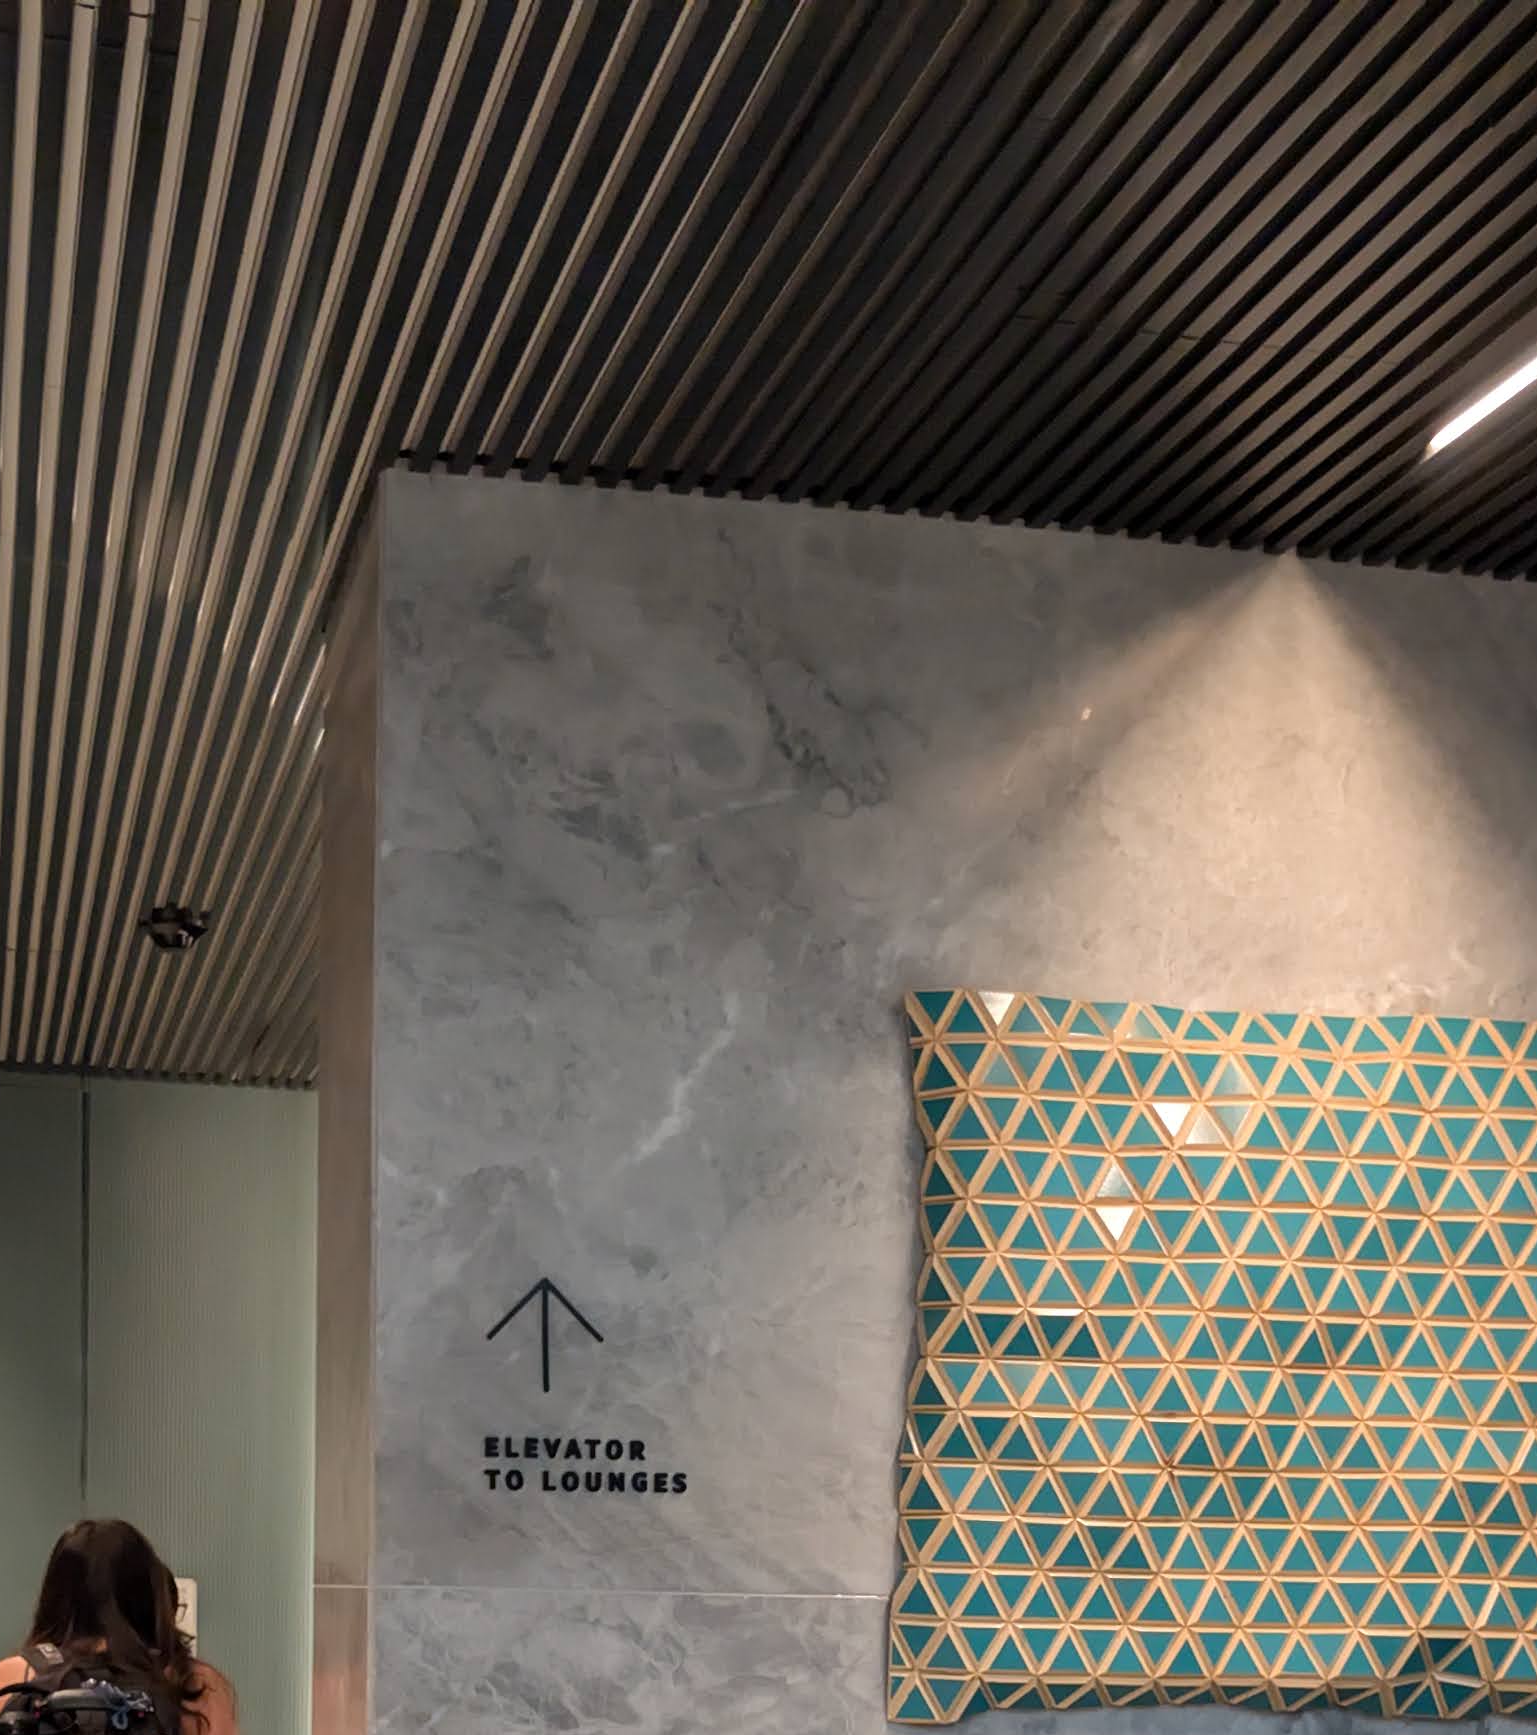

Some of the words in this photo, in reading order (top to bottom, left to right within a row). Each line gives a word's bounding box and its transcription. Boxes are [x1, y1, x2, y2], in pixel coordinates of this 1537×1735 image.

[483, 1436, 646, 1461] ELEVATOR
[483, 1469, 525, 1491] TO
[541, 1470, 688, 1494] LOUNGES
